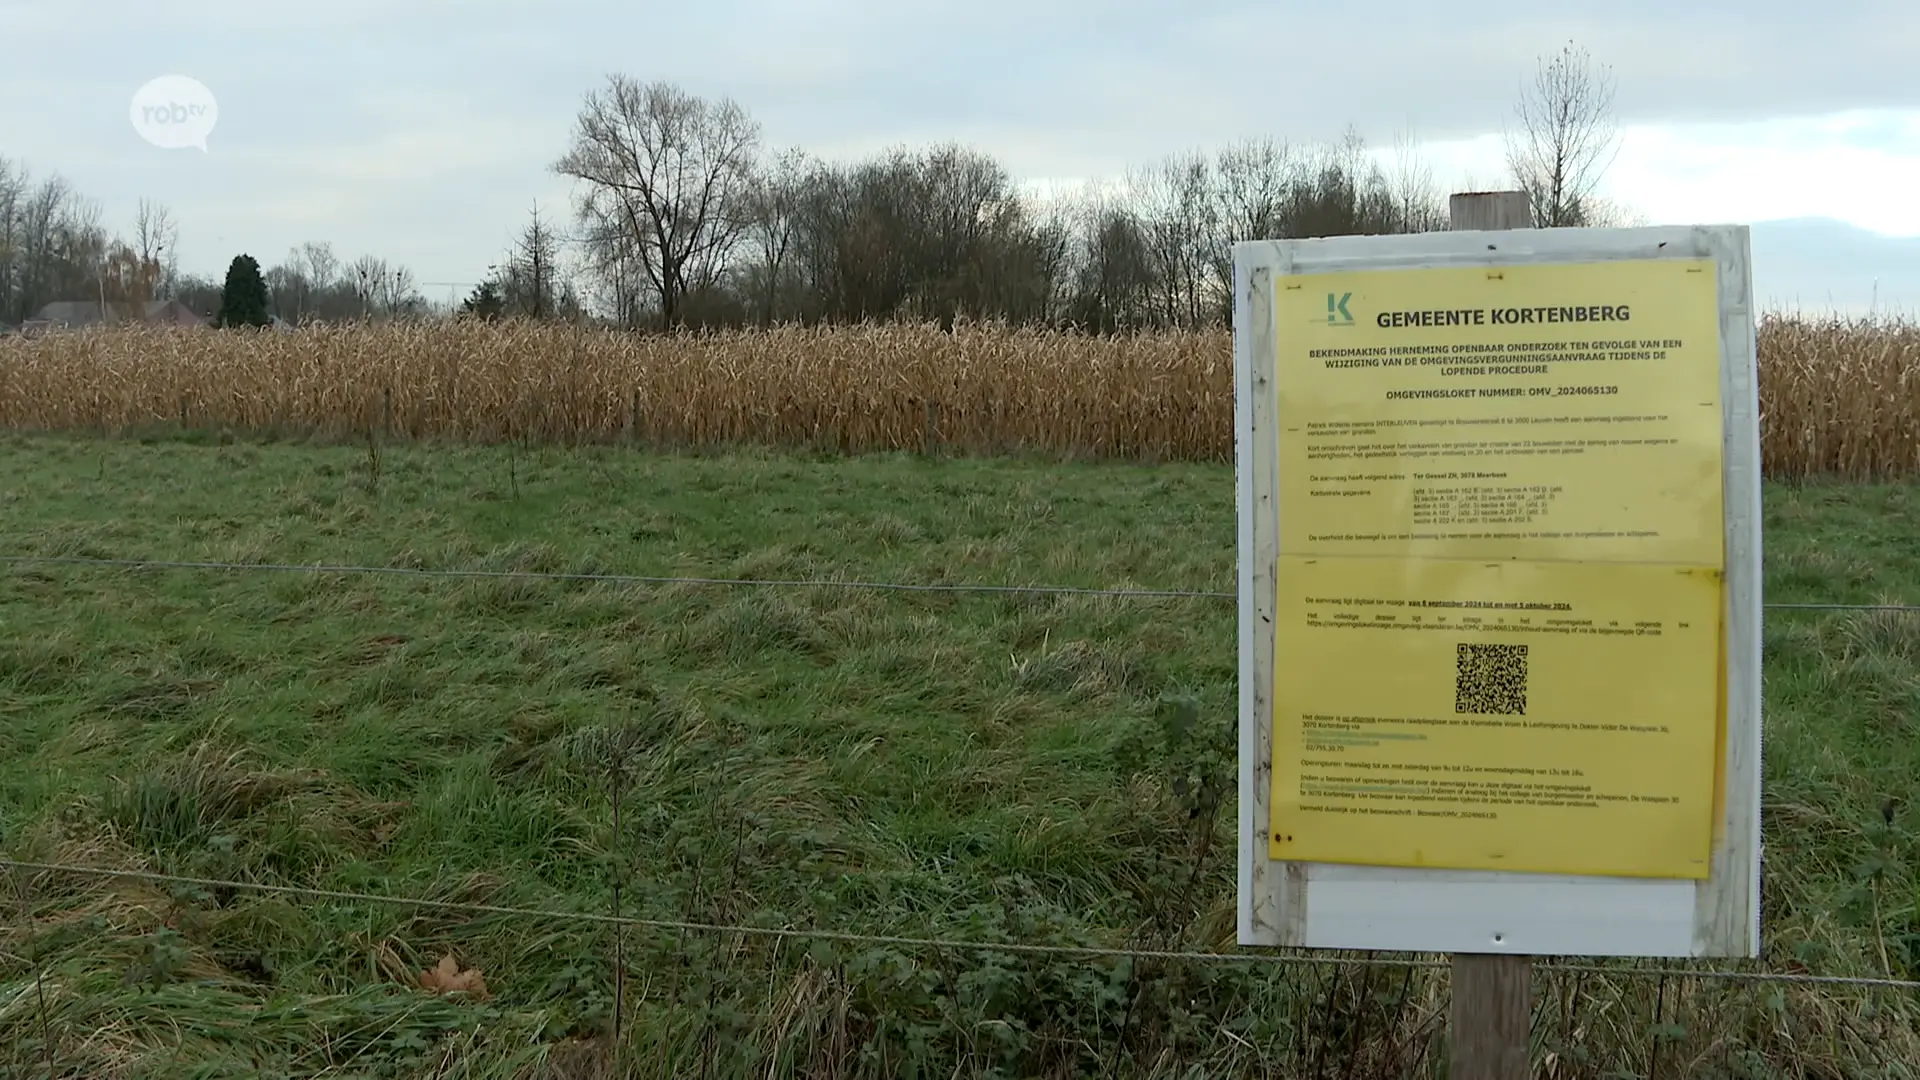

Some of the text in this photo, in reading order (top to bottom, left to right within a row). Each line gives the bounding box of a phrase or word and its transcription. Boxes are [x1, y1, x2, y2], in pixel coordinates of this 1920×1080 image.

[1376, 305, 1630, 328] GEMEENTE KORTENBERG
[1309, 340, 1682, 358] BEKENDMAKING HERNEMING OPENBAAR ONDERZOEK TEN GEVOLGE VAN EEN
[1325, 351, 1666, 368] WIJZIGING VAN DE OMGEVINGSVERGUNNINGSAANVRAAG TIJDENS DE
[1441, 365, 1548, 376] LOPENDE PROCEDURE
[1386, 386, 1618, 400] OMGEVINGSLOKET NUMMER: OMV_2024065130
[1428, 600, 1463, 608] september
[1465, 601, 1481, 609] 2024
[1525, 602, 1551, 610] oktober
